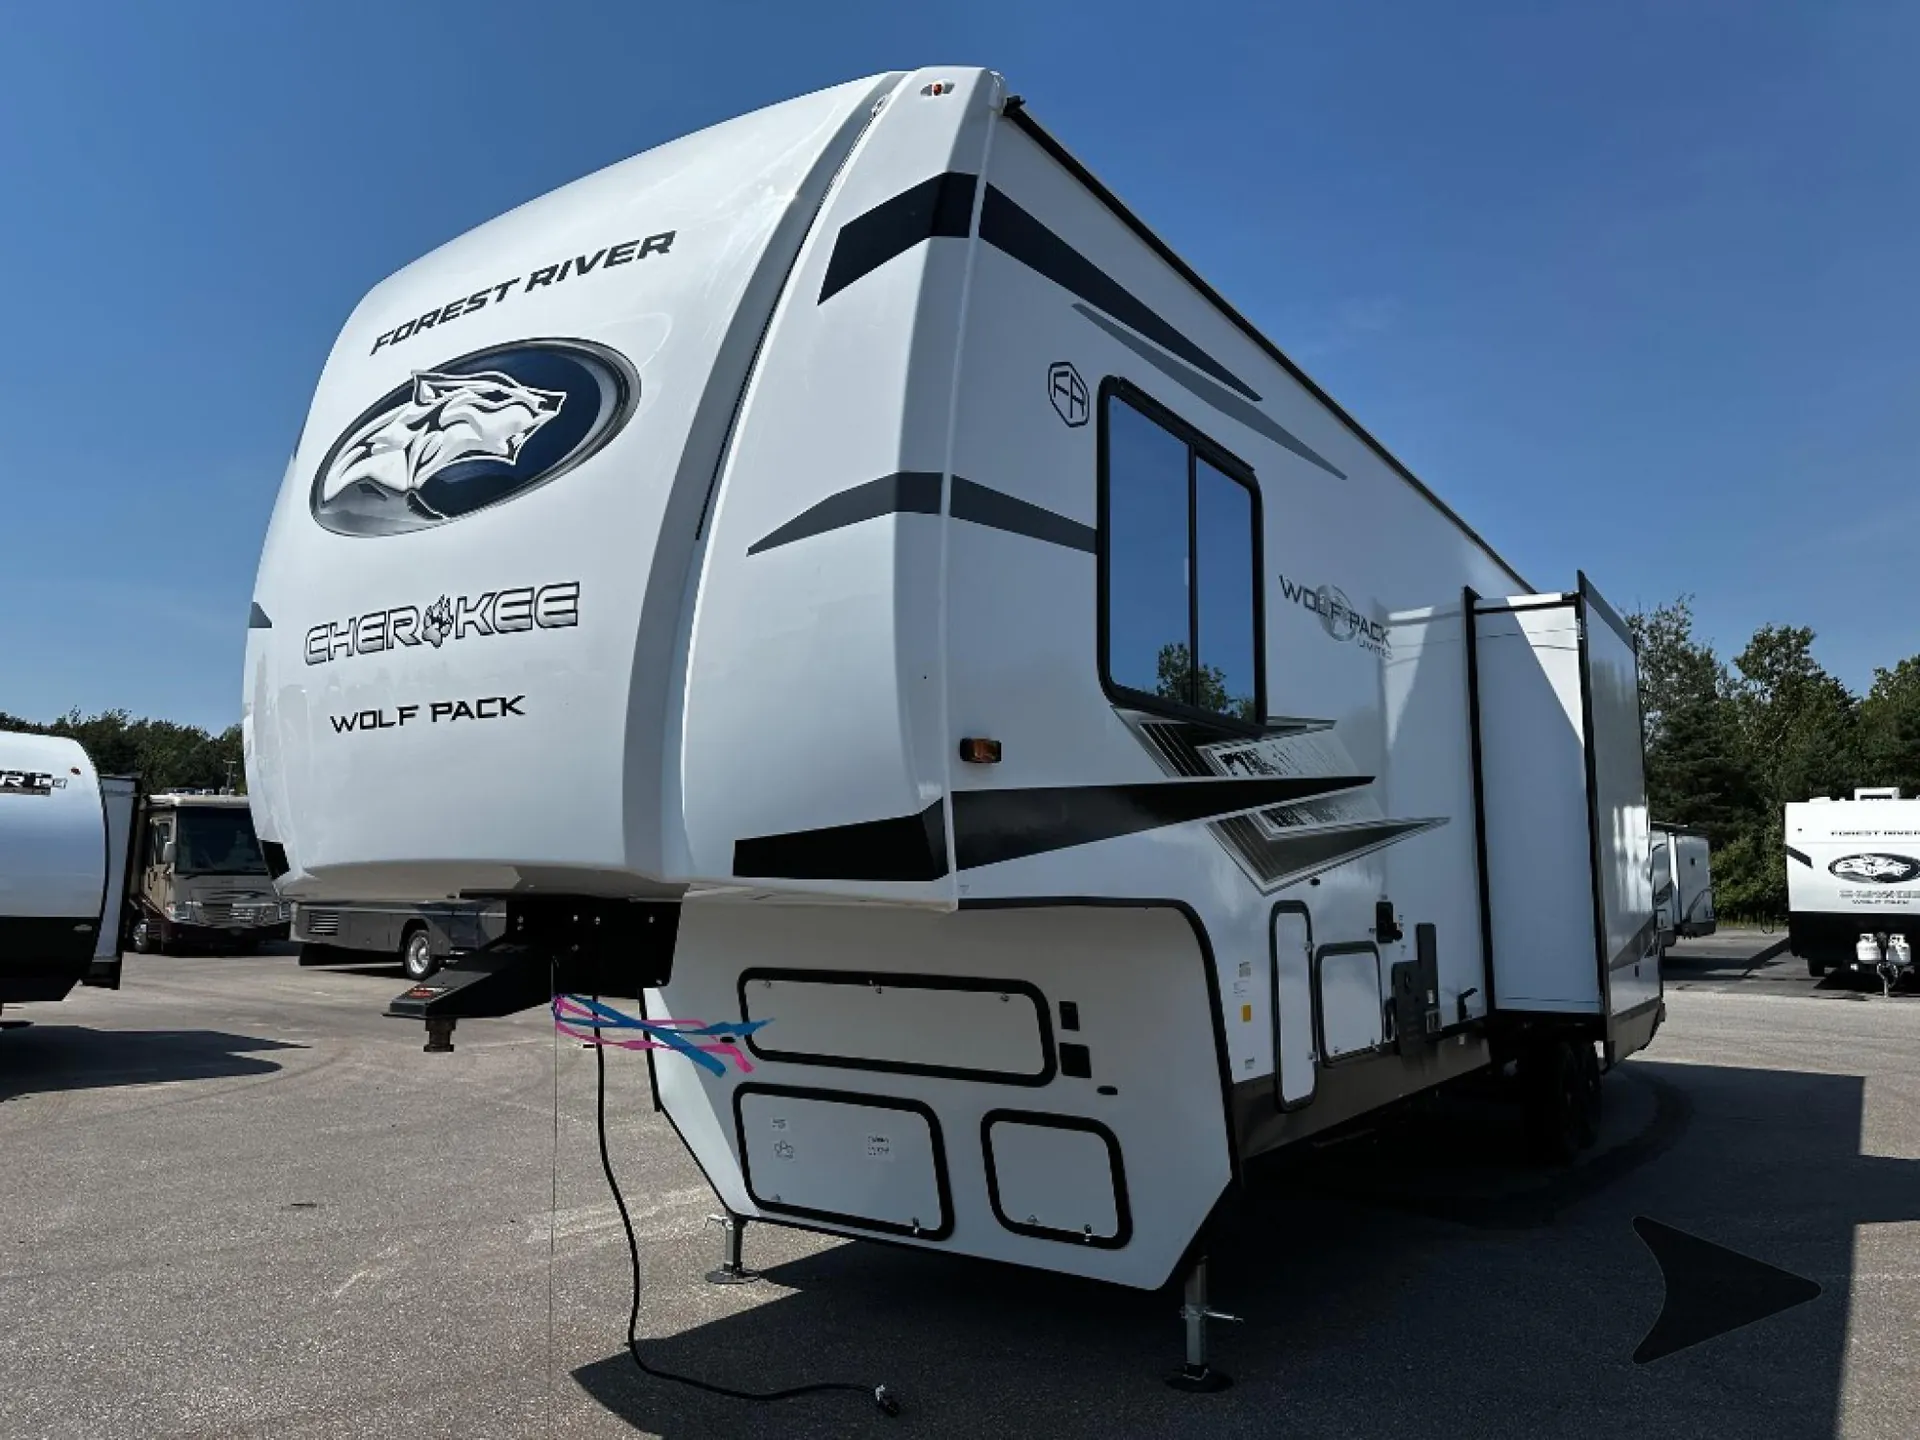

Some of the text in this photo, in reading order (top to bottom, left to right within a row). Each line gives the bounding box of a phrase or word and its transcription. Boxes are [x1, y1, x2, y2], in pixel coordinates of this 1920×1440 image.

[371, 230, 677, 356] FOREST RIVER
[304, 581, 580, 666] CHEROKEE
[1278, 574, 1392, 649] WOLF PACK
[330, 695, 526, 733] WOLF PACK
